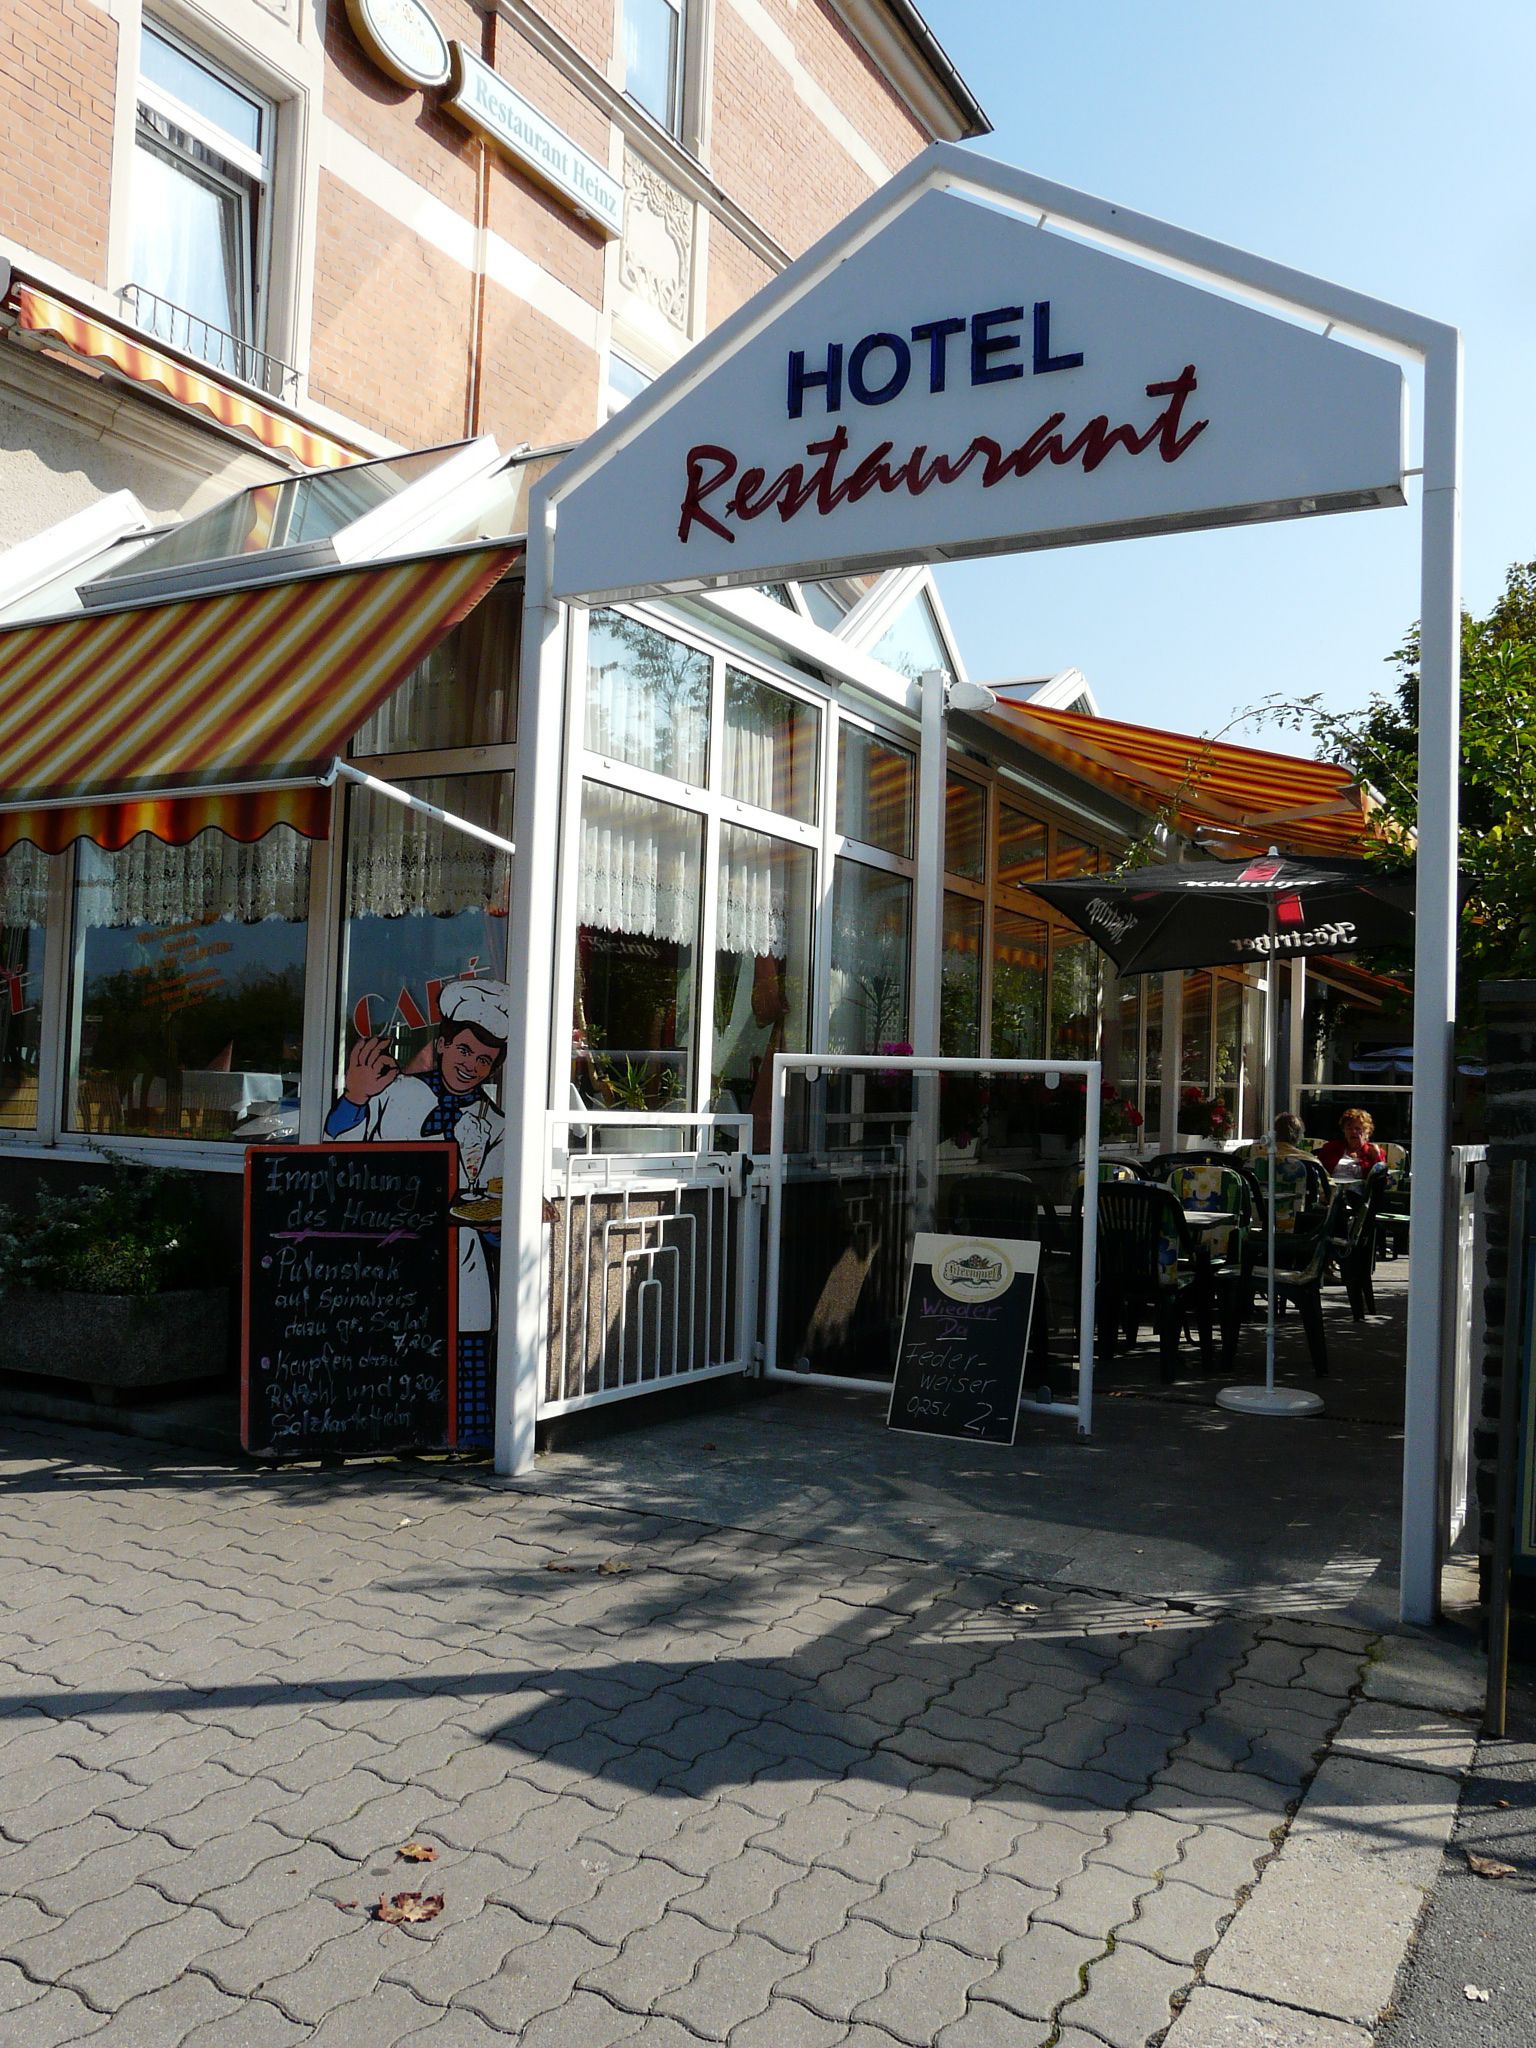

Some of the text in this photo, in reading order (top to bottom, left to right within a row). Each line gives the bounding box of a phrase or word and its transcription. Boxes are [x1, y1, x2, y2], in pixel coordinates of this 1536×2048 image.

[475, 73, 618, 217] Restaurant Heinz
[787, 301, 1084, 420] HOTEL
[678, 364, 1210, 544] Restaurant
[353, 956, 491, 1038] CAF
[264, 1155, 421, 1211] Empfehlung
[287, 1198, 439, 1232] des Hauses
[276, 1246, 401, 1287] Putensteak
[274, 1282, 418, 1316] auf Spinatreis
[921, 1297, 1003, 1317] Wieder
[284, 1315, 328, 1338] dazu
[368, 1306, 431, 1334] Salat
[275, 1341, 400, 1383] Karpfen dazu
[905, 1343, 988, 1372] Feder-
[346, 1375, 392, 1401] und
